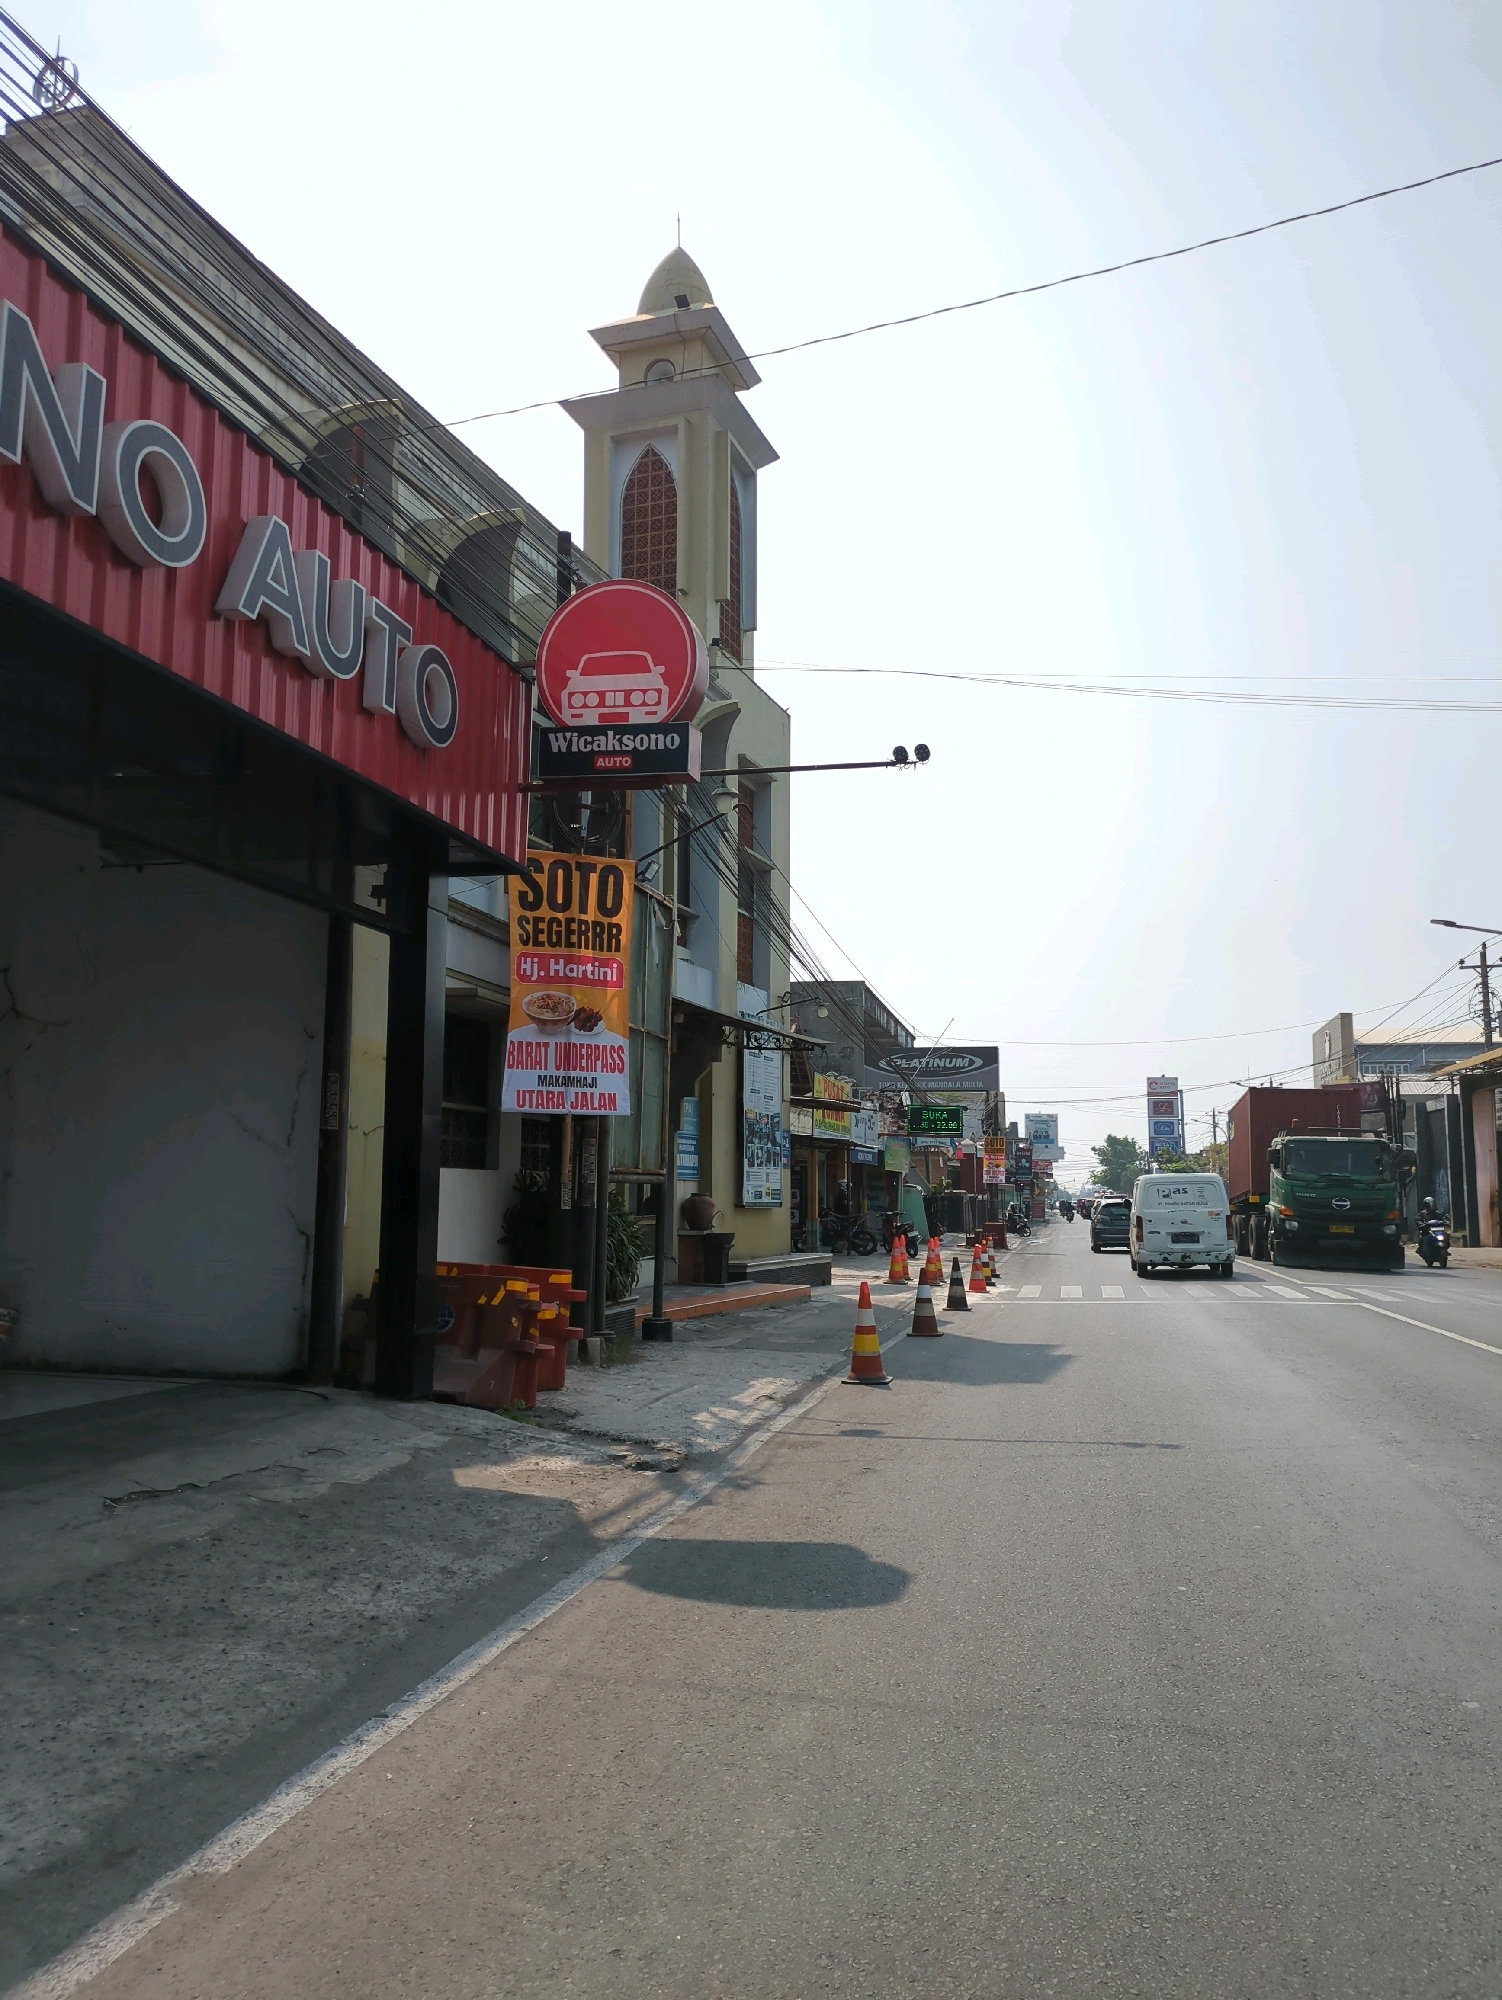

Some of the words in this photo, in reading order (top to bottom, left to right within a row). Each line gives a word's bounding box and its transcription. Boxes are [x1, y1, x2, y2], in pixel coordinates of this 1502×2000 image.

[216, 515, 458, 748] AUTO
[548, 730, 680, 753] Wicaksono
[596, 756, 631, 767] AUTO
[517, 858, 624, 918] SOTO
[516, 914, 622, 953] SEGERRR
[520, 956, 545, 981] Hj.
[549, 958, 618, 982] Hartini
[507, 1040, 549, 1071] BARAT
[554, 1041, 625, 1074] UNDERPASS
[892, 1057, 969, 1068] PLATINUM
[537, 1074, 597, 1089] MAKAMHAJI
[516, 1089, 565, 1110] UTARA
[570, 1091, 617, 1111] JALAN
[922, 1110, 948, 1119] BUKA
[985, 1137, 1004, 1147] SOTO
